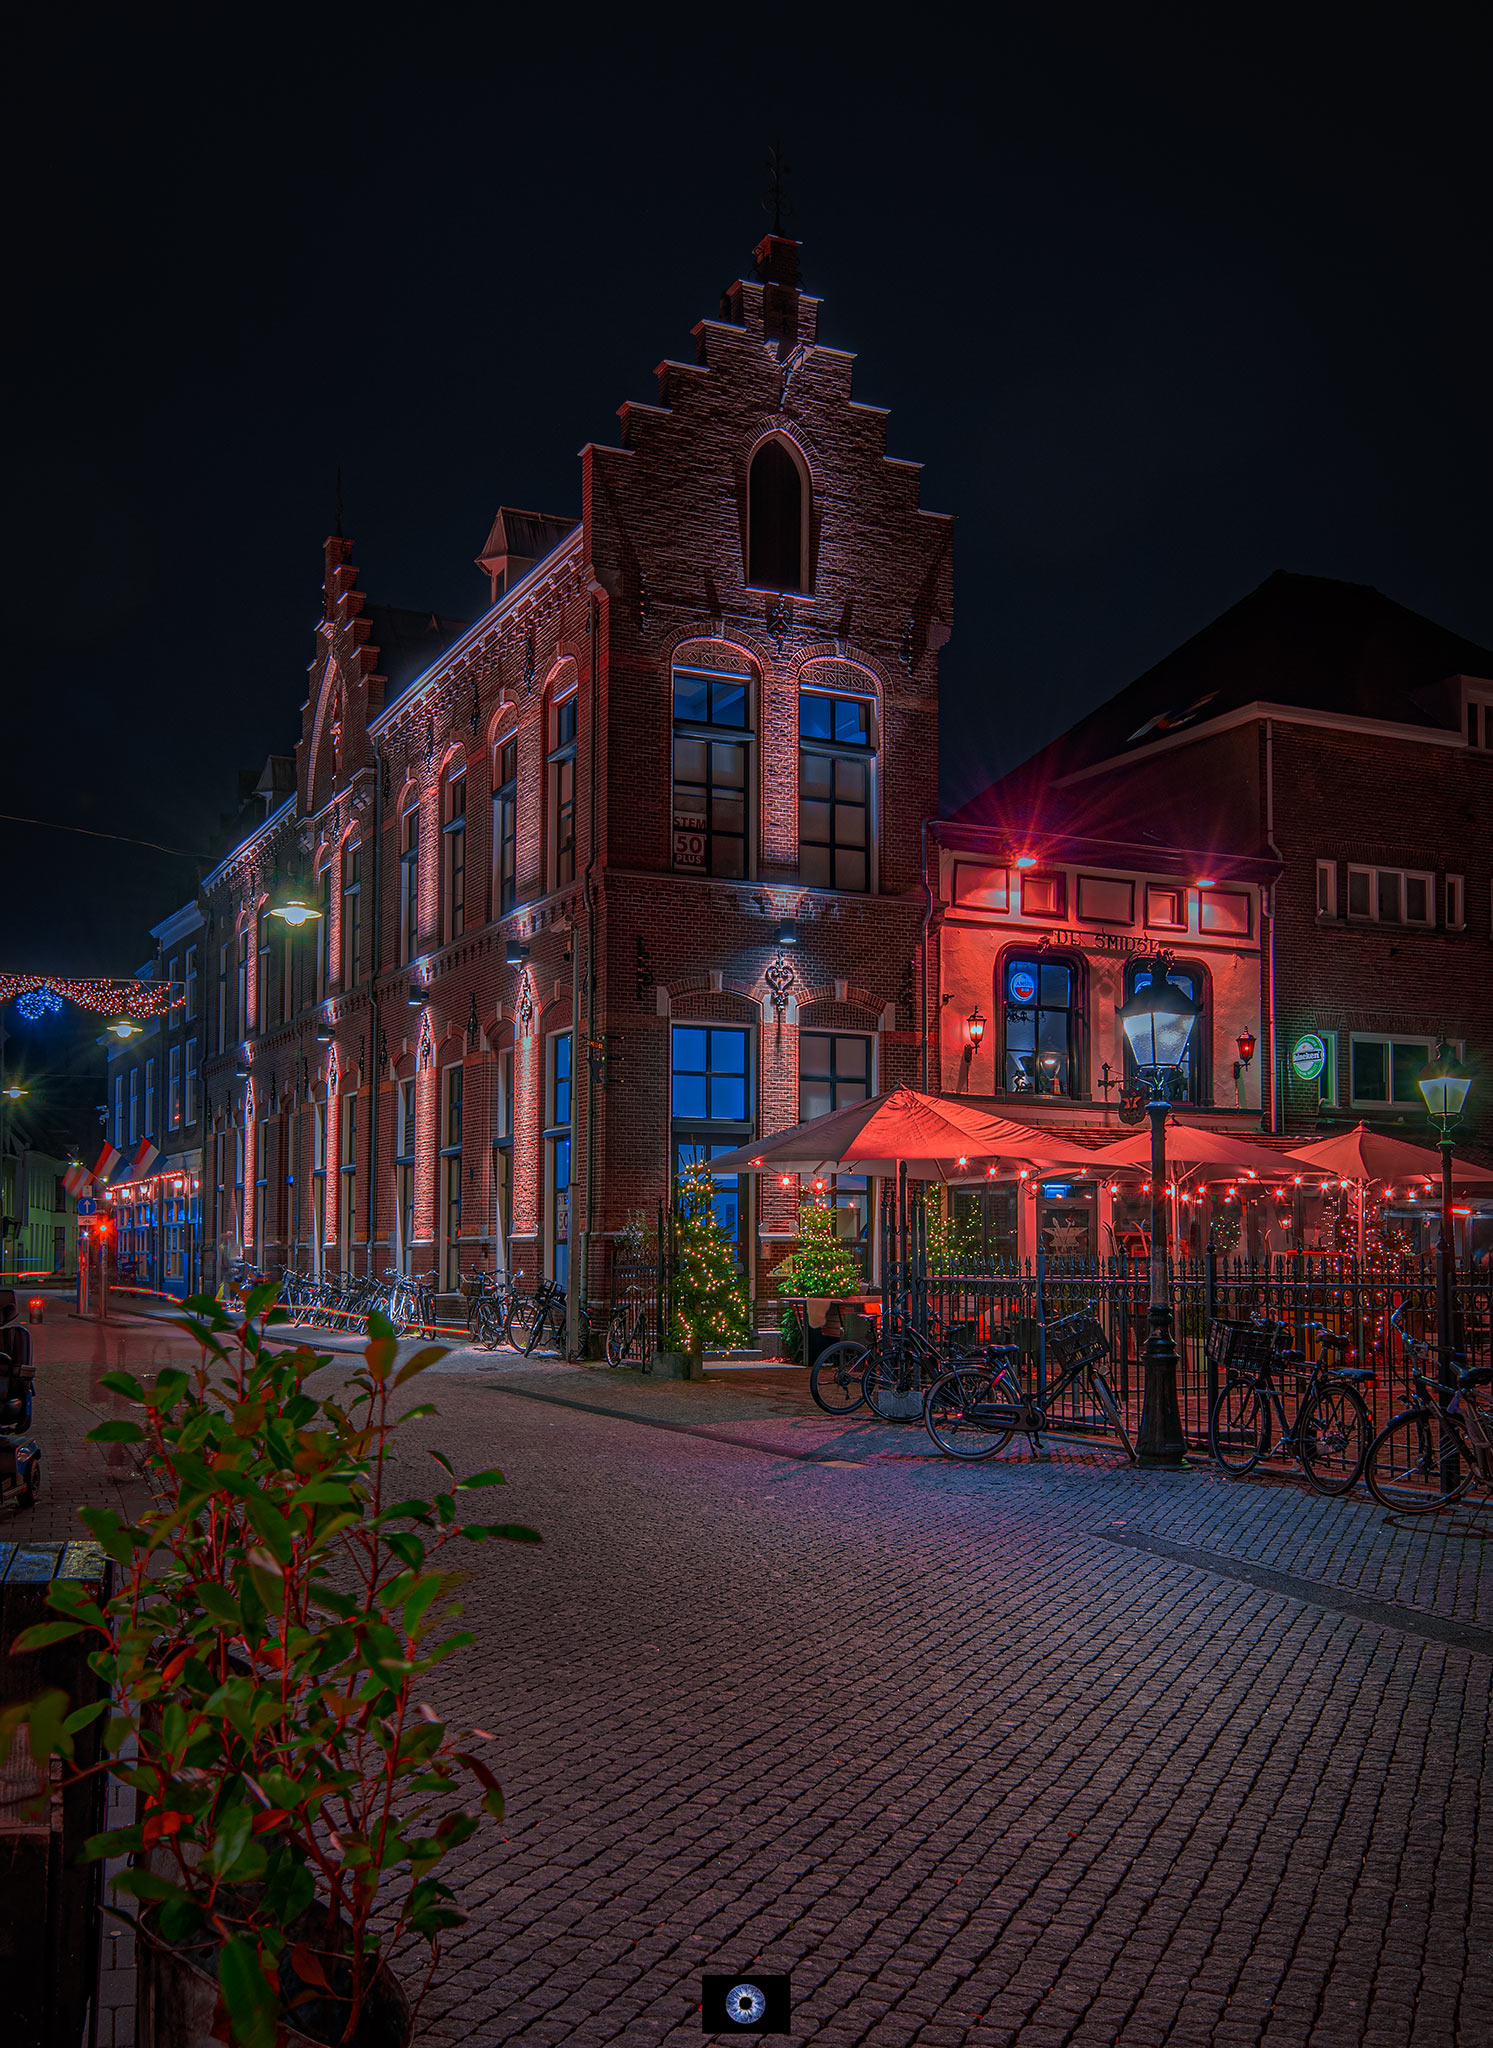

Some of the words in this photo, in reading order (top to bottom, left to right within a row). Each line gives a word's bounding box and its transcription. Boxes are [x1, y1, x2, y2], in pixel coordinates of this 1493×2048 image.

[673, 816, 706, 829] STEM
[676, 835, 703, 854] 50
[676, 854, 702, 864] PLUS
[1056, 930, 1081, 945] DE
